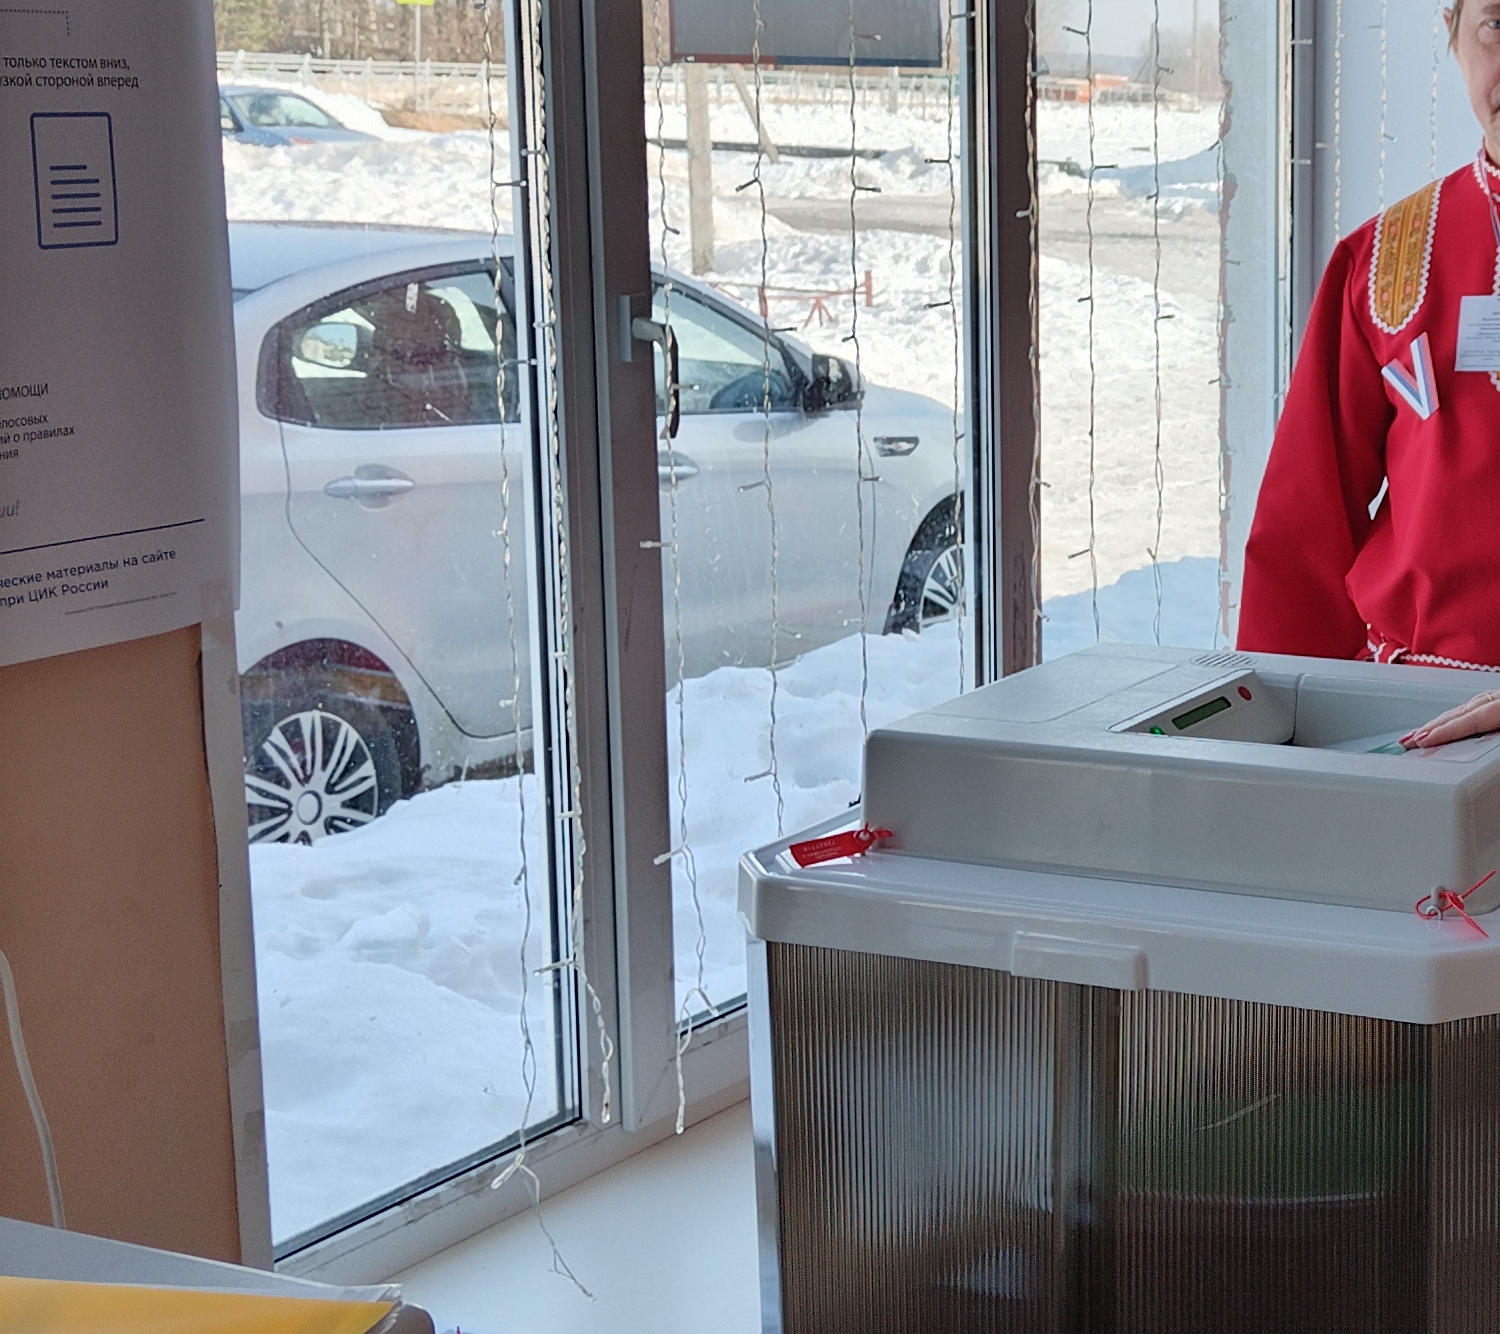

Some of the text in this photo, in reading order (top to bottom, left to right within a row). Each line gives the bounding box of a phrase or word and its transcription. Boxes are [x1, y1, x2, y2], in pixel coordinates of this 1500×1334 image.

[3, 57, 130, 70] только текстом вниз,
[0, 72, 139, 89] зкой стороной вперед
[0, 382, 49, 400] ОМОЩИ
[0, 414, 48, 429] лосовых
[23, 426, 75, 443] правилах
[46, 559, 119, 580] материалы
[123, 555, 138, 567] на
[142, 549, 176, 564] сайте
[0, 578, 109, 608] при ЦИК России
